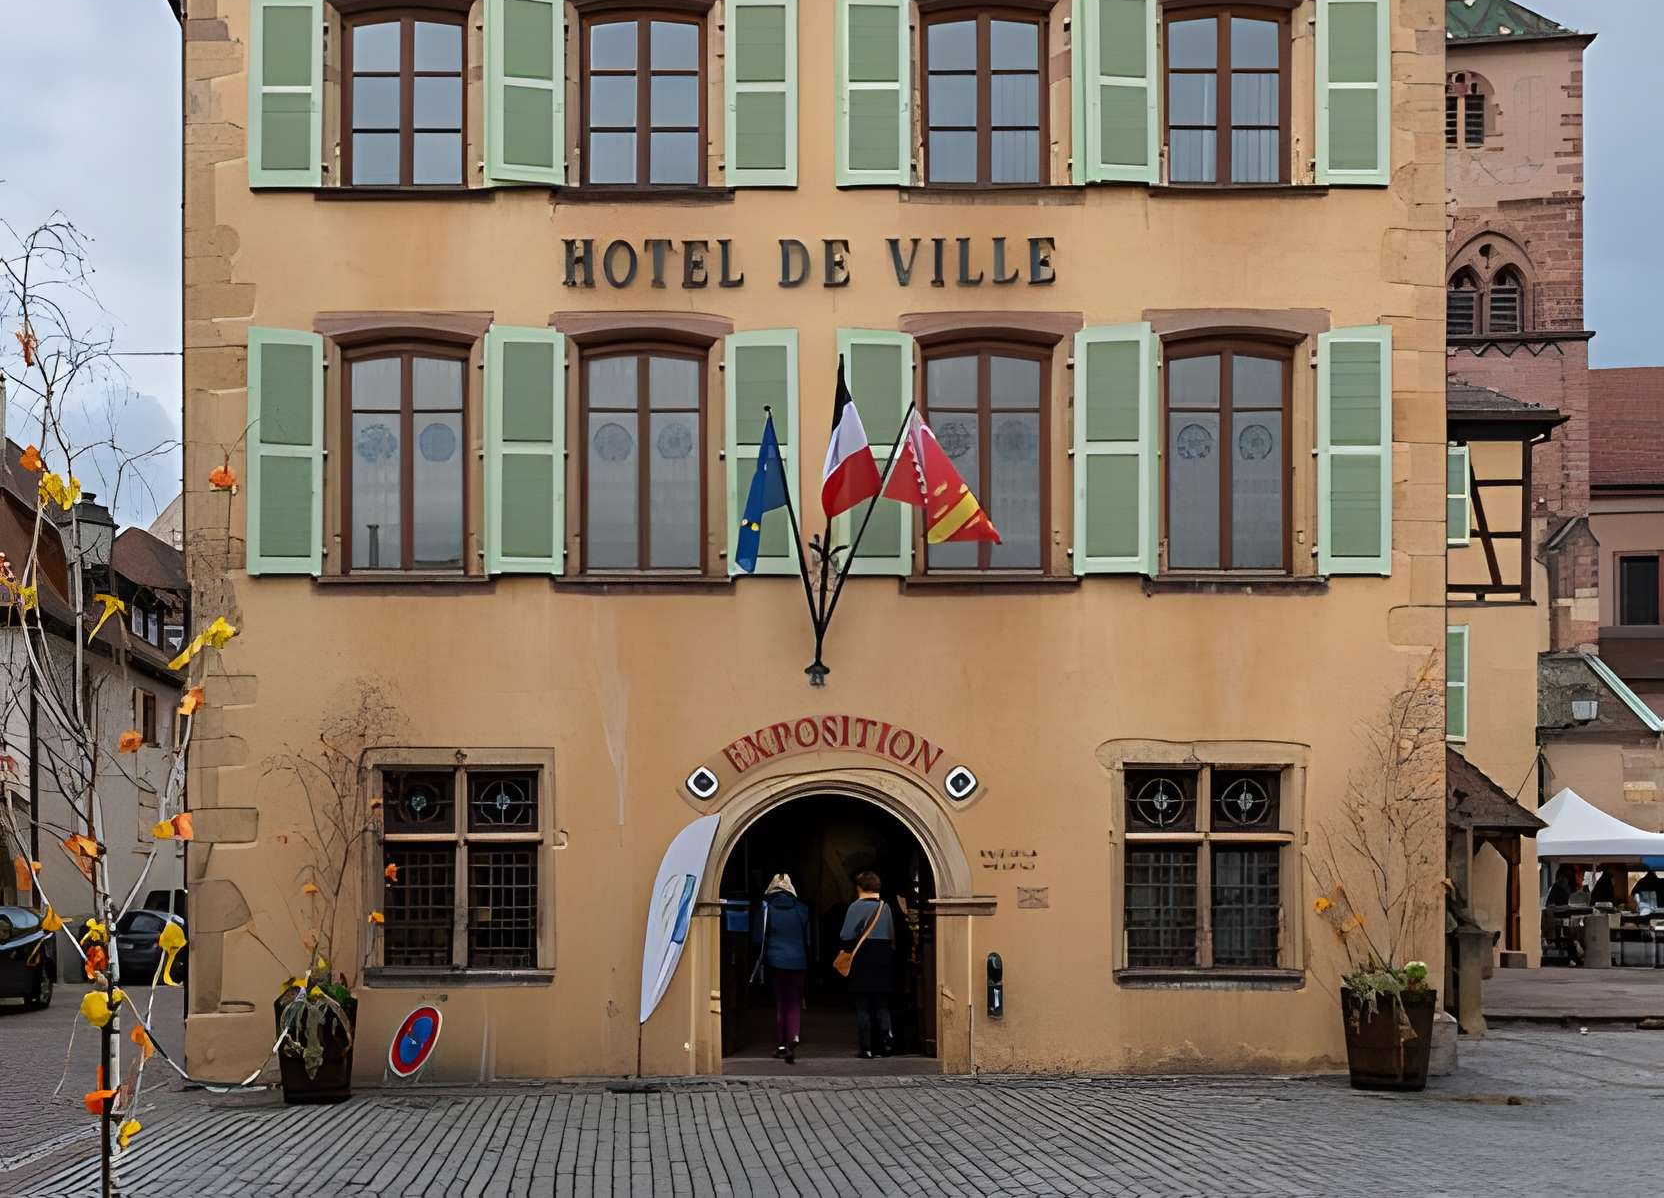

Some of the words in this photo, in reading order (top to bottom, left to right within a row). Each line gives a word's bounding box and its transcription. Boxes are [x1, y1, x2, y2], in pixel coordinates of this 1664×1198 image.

[561, 238, 744, 289] HOTEL
[778, 238, 850, 288] DE
[885, 237, 1056, 288] VILLE
[721, 715, 945, 775] EXPOSITION
